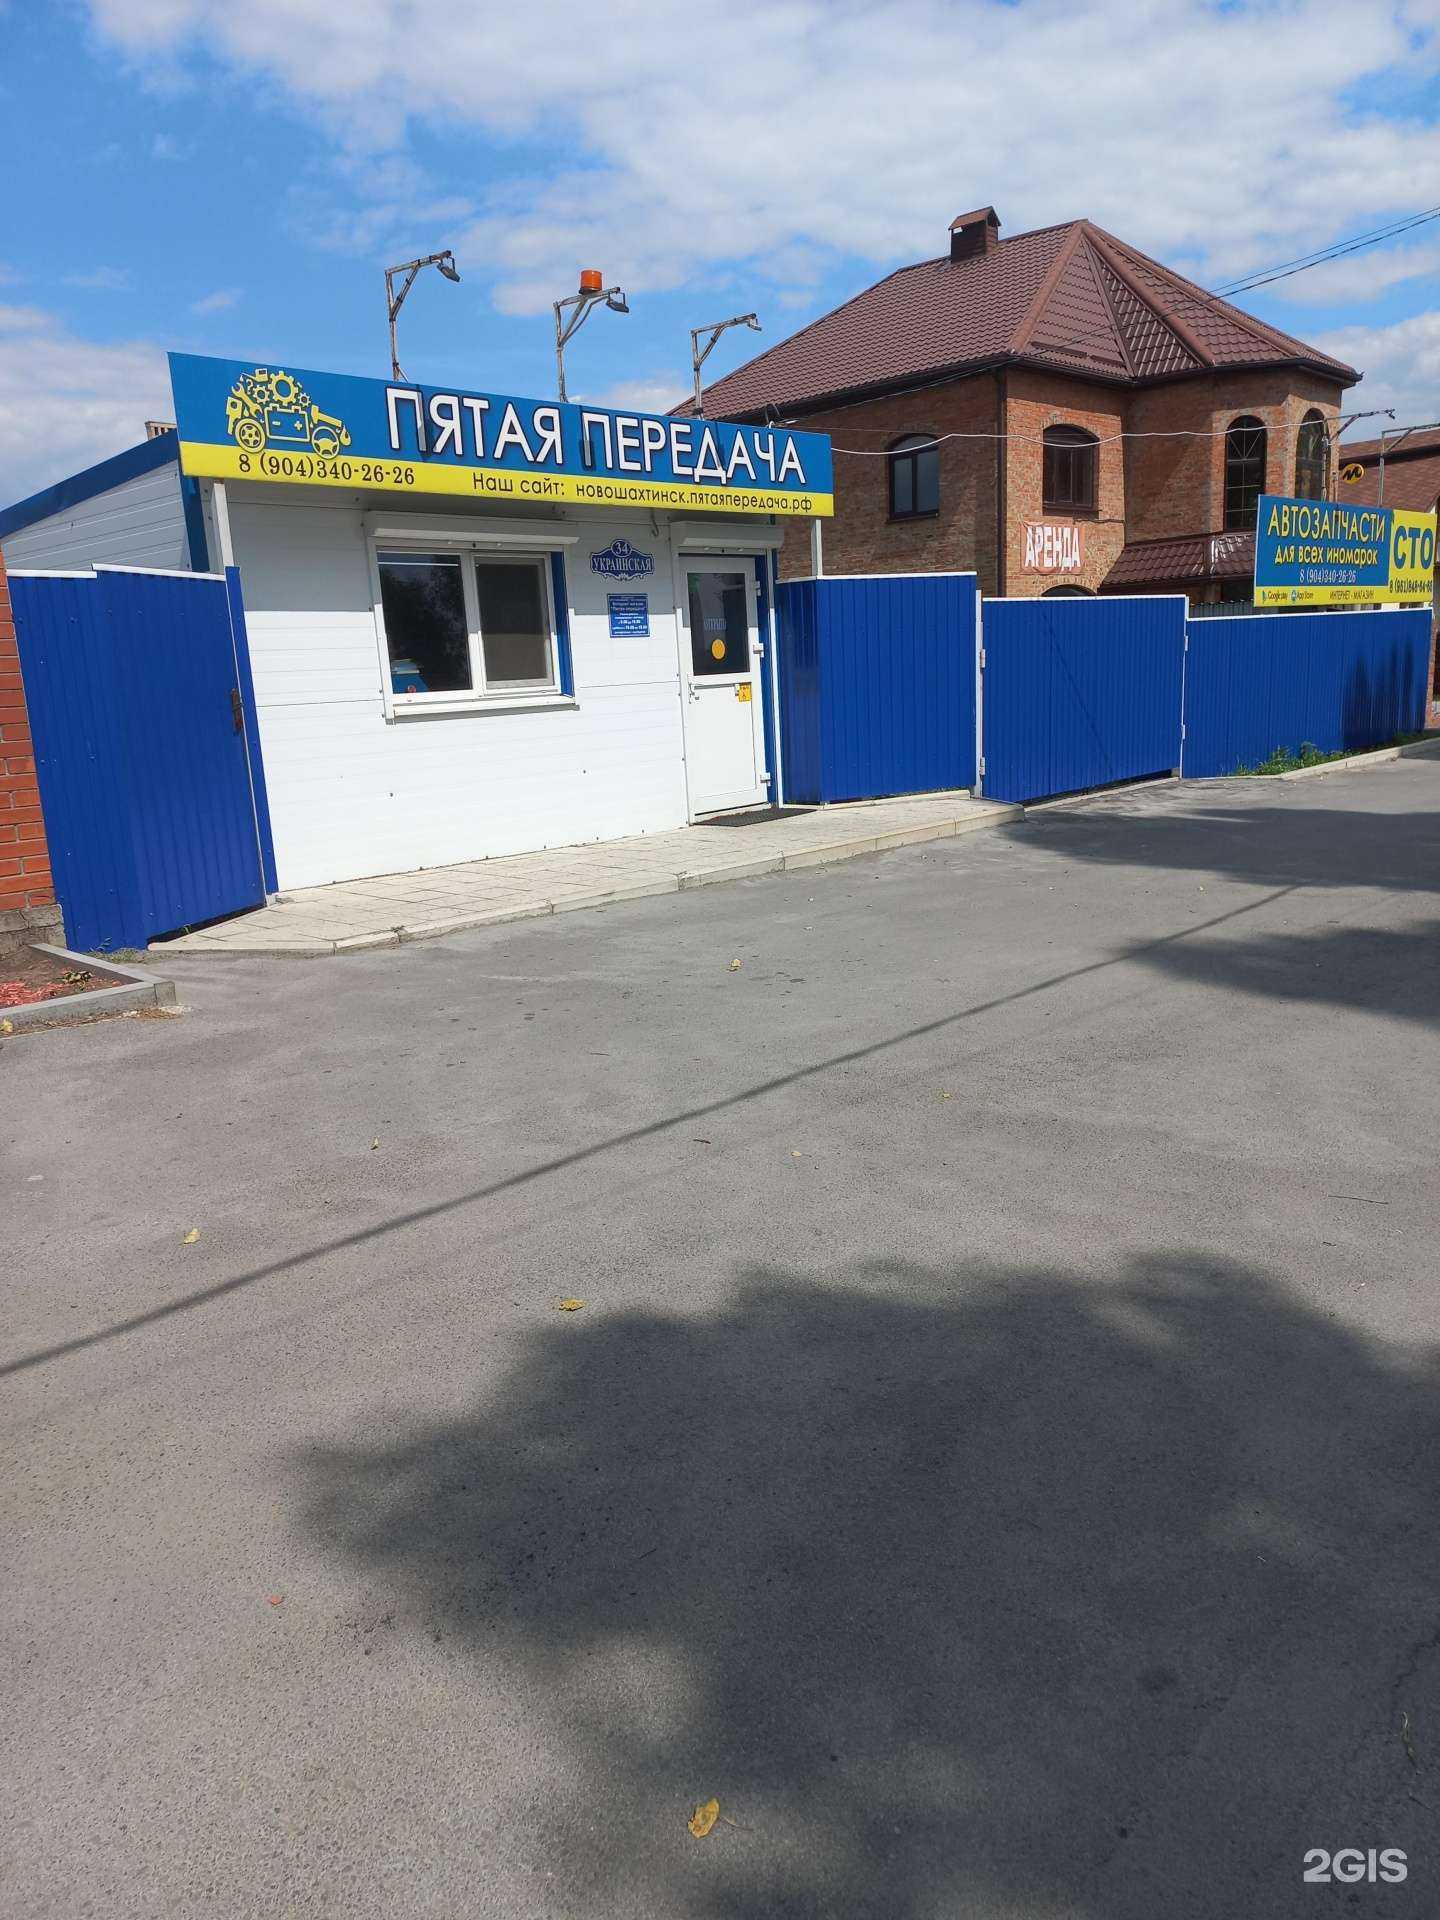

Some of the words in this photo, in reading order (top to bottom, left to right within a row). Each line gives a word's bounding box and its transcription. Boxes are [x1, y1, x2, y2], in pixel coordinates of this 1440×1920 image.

[386, 387, 563, 464] ПЯТАЯ
[582, 412, 806, 485] ПЕРЕДАЧА
[239, 453, 251, 473] 8
[260, 453, 415, 485] (904)340-26-26
[473, 472, 513, 492] Наш
[520, 478, 565, 496] сайт:
[576, 483, 812, 512] новошахтинск.пятаяпередача.рф
[1267, 504, 1386, 542] АВТОЗАПЧАСТИ
[592, 557, 651, 571] УКРАИНСКАЯ
[615, 542, 629, 554] 34
[1025, 526, 1081, 571] АРЕНДА
[1275, 545, 1295, 565] для
[1299, 545, 1323, 564] всех
[1327, 547, 1378, 568] иномарок
[1394, 525, 1434, 569] СТО
[1300, 570, 1305, 583] 8
[1306, 568, 1356, 583] (904)340-26-26
